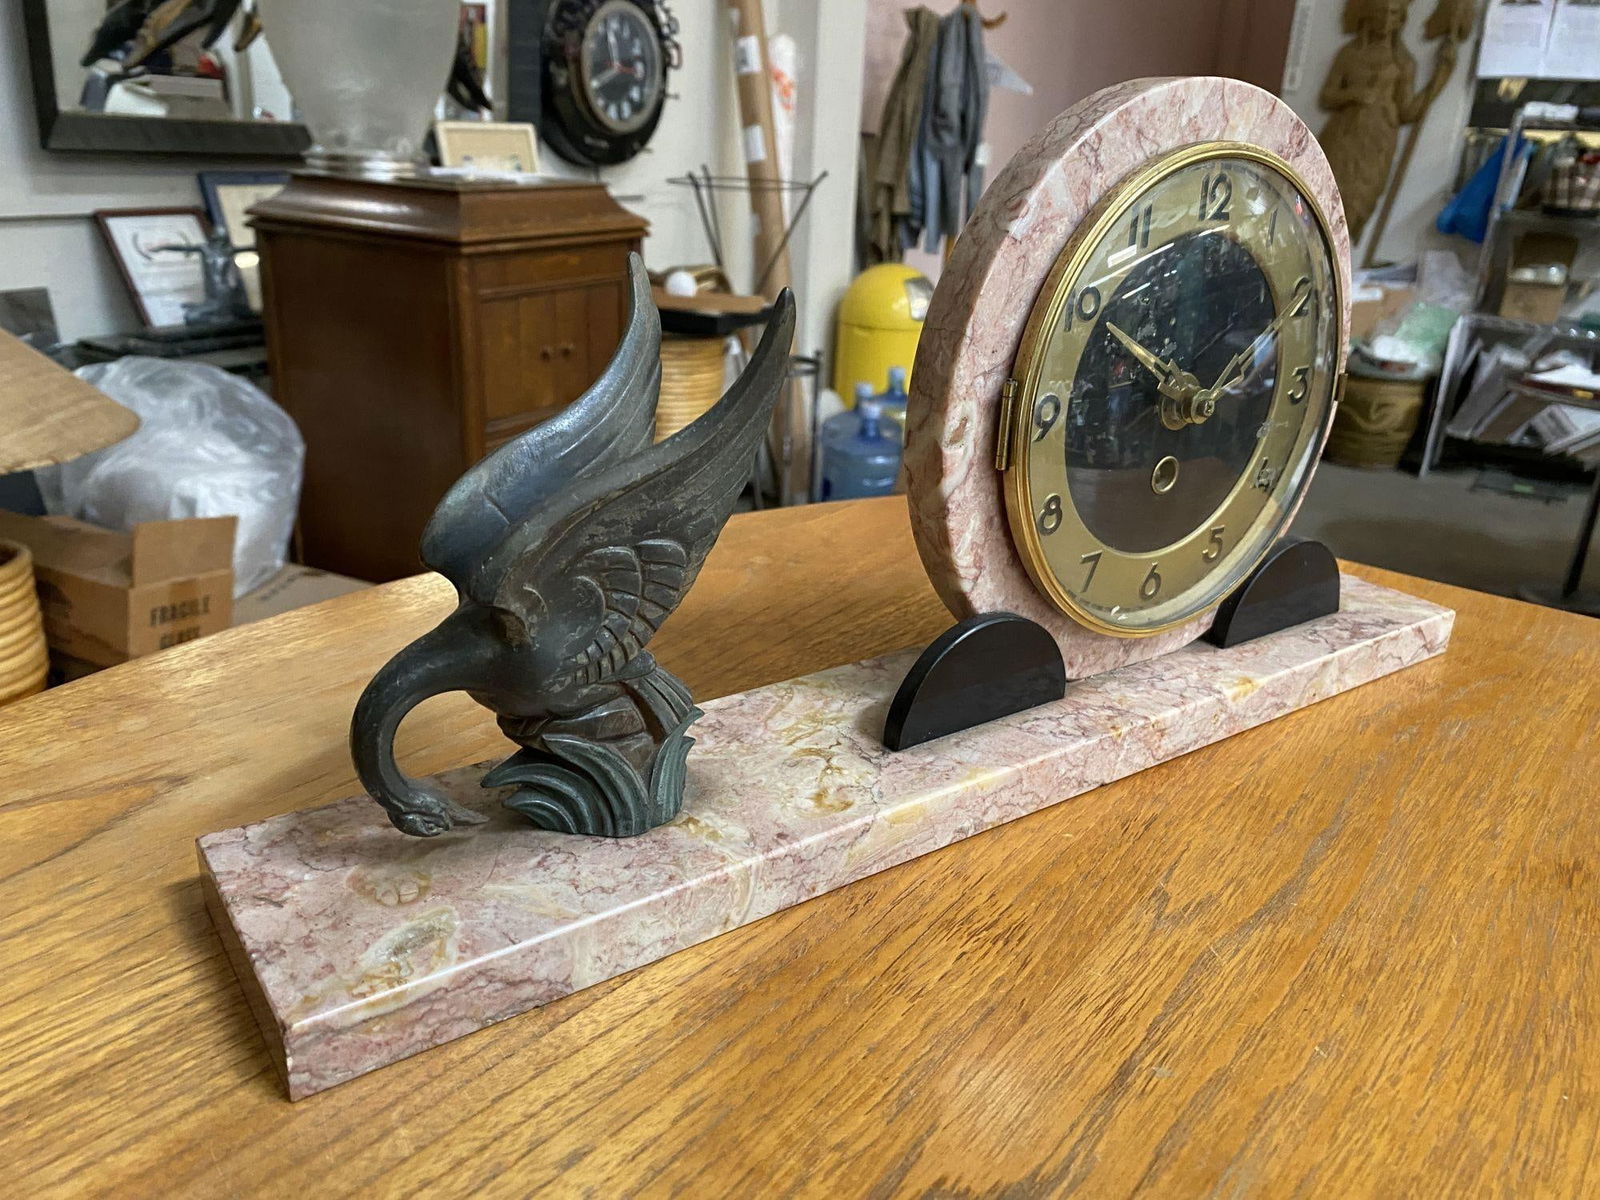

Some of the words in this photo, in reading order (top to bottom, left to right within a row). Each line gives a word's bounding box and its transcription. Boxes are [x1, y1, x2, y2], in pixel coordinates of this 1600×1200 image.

[1199, 173, 1232, 221] 12
[1128, 203, 1153, 248] 11
[1266, 208, 1279, 247] 1
[1064, 285, 1101, 332] 10
[1292, 275, 1312, 316] 2
[1287, 366, 1309, 405] 3
[1034, 394, 1061, 443] 9
[1255, 456, 1280, 493] 4
[1037, 493, 1063, 536] 8
[1202, 524, 1226, 563] 5
[1080, 550, 1103, 593] 7
[1139, 561, 1162, 600] 6
